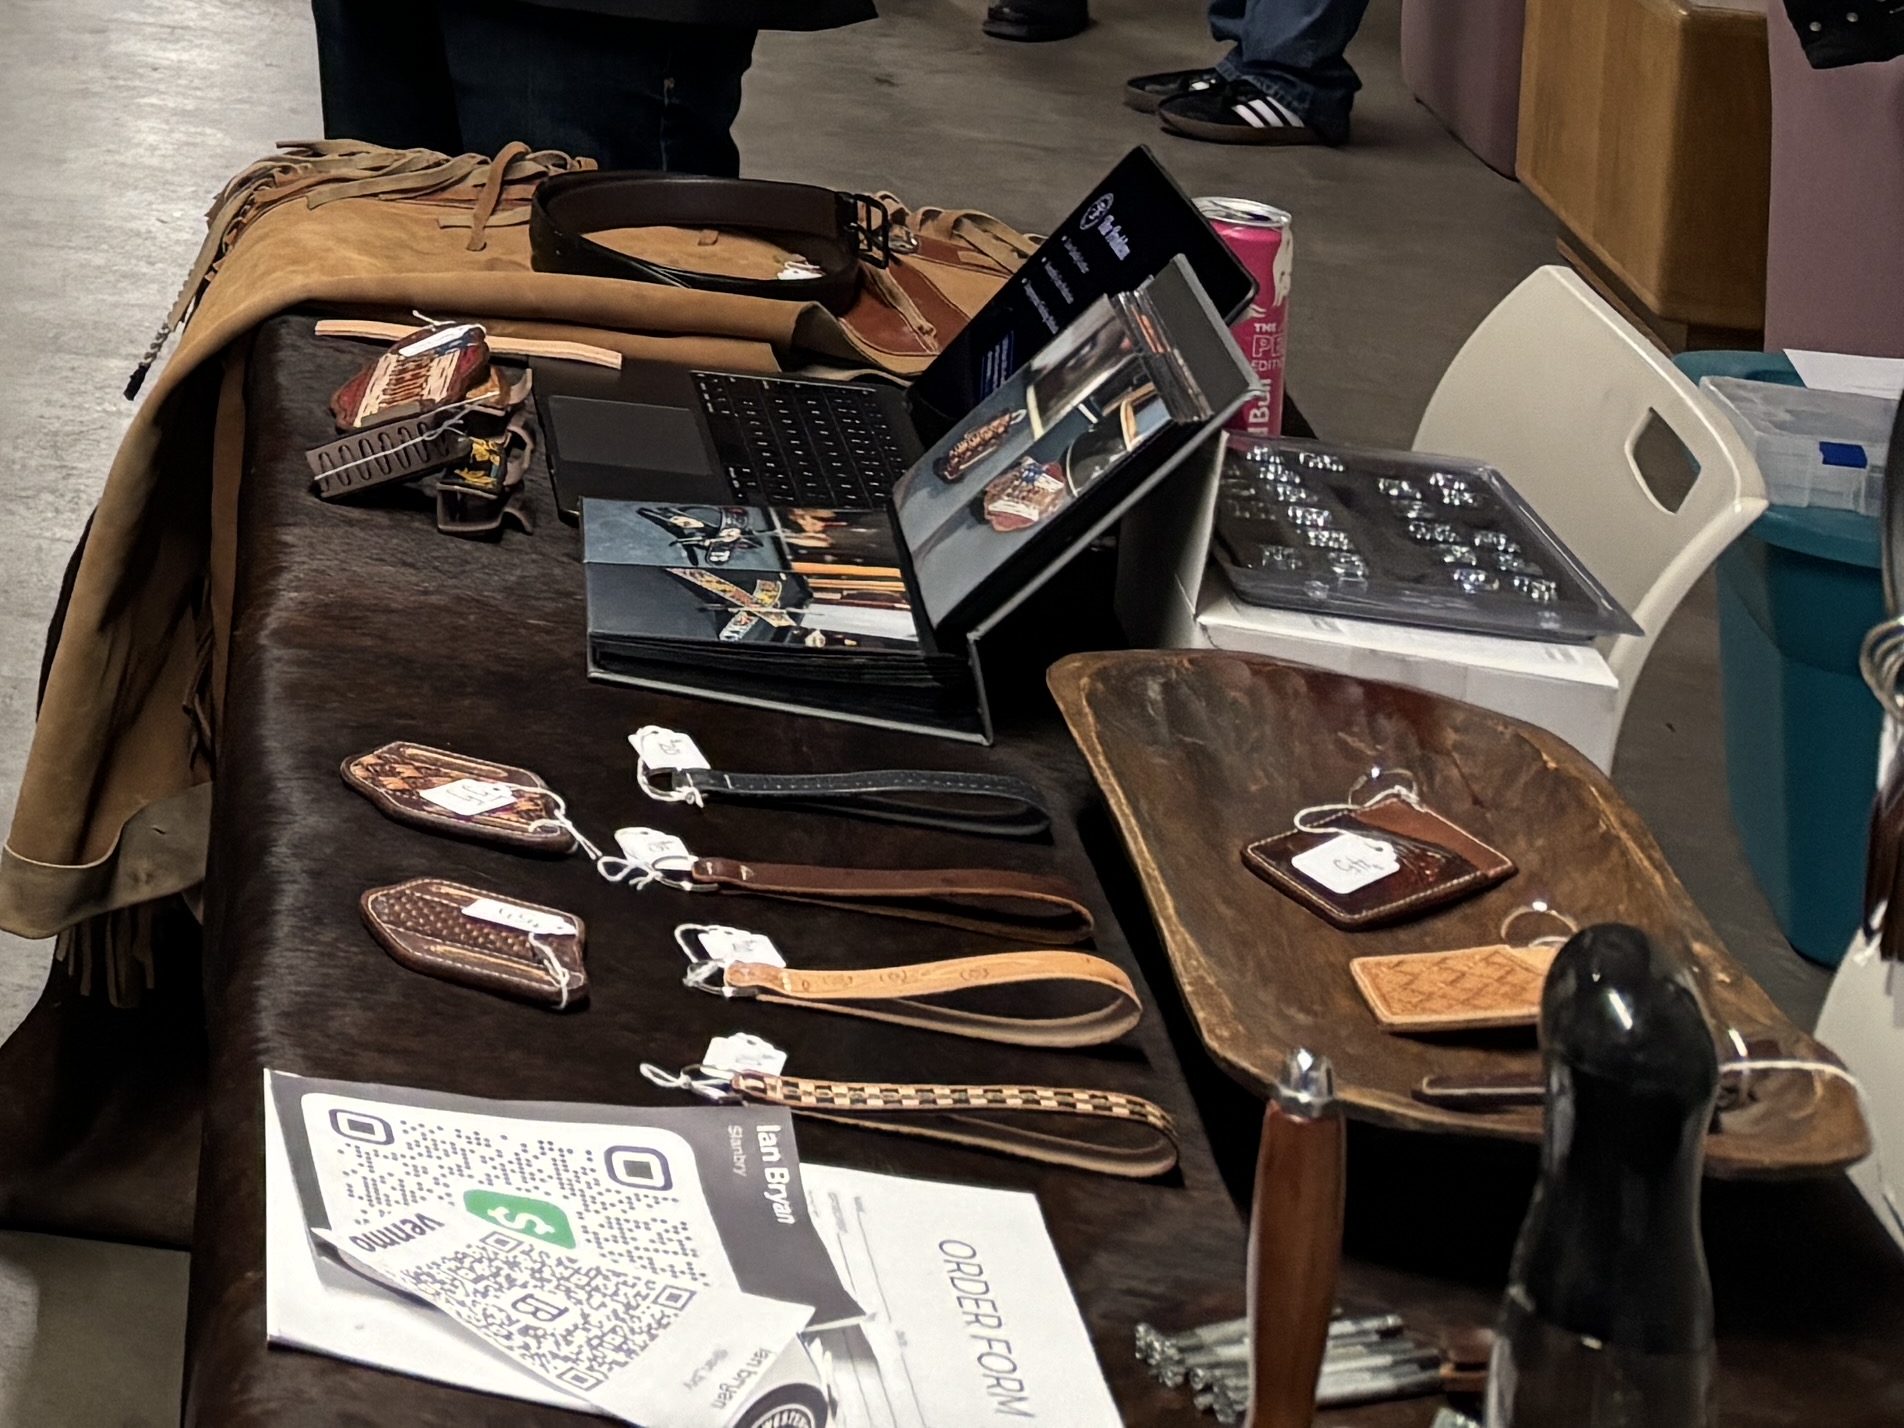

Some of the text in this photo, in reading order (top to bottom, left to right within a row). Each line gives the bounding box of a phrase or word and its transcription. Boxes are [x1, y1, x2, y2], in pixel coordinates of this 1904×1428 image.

[755, 1124, 797, 1226] Ian Bryan
[349, 1213, 445, 1253] venmo
[938, 1239, 1036, 1418] ORDER FORM
